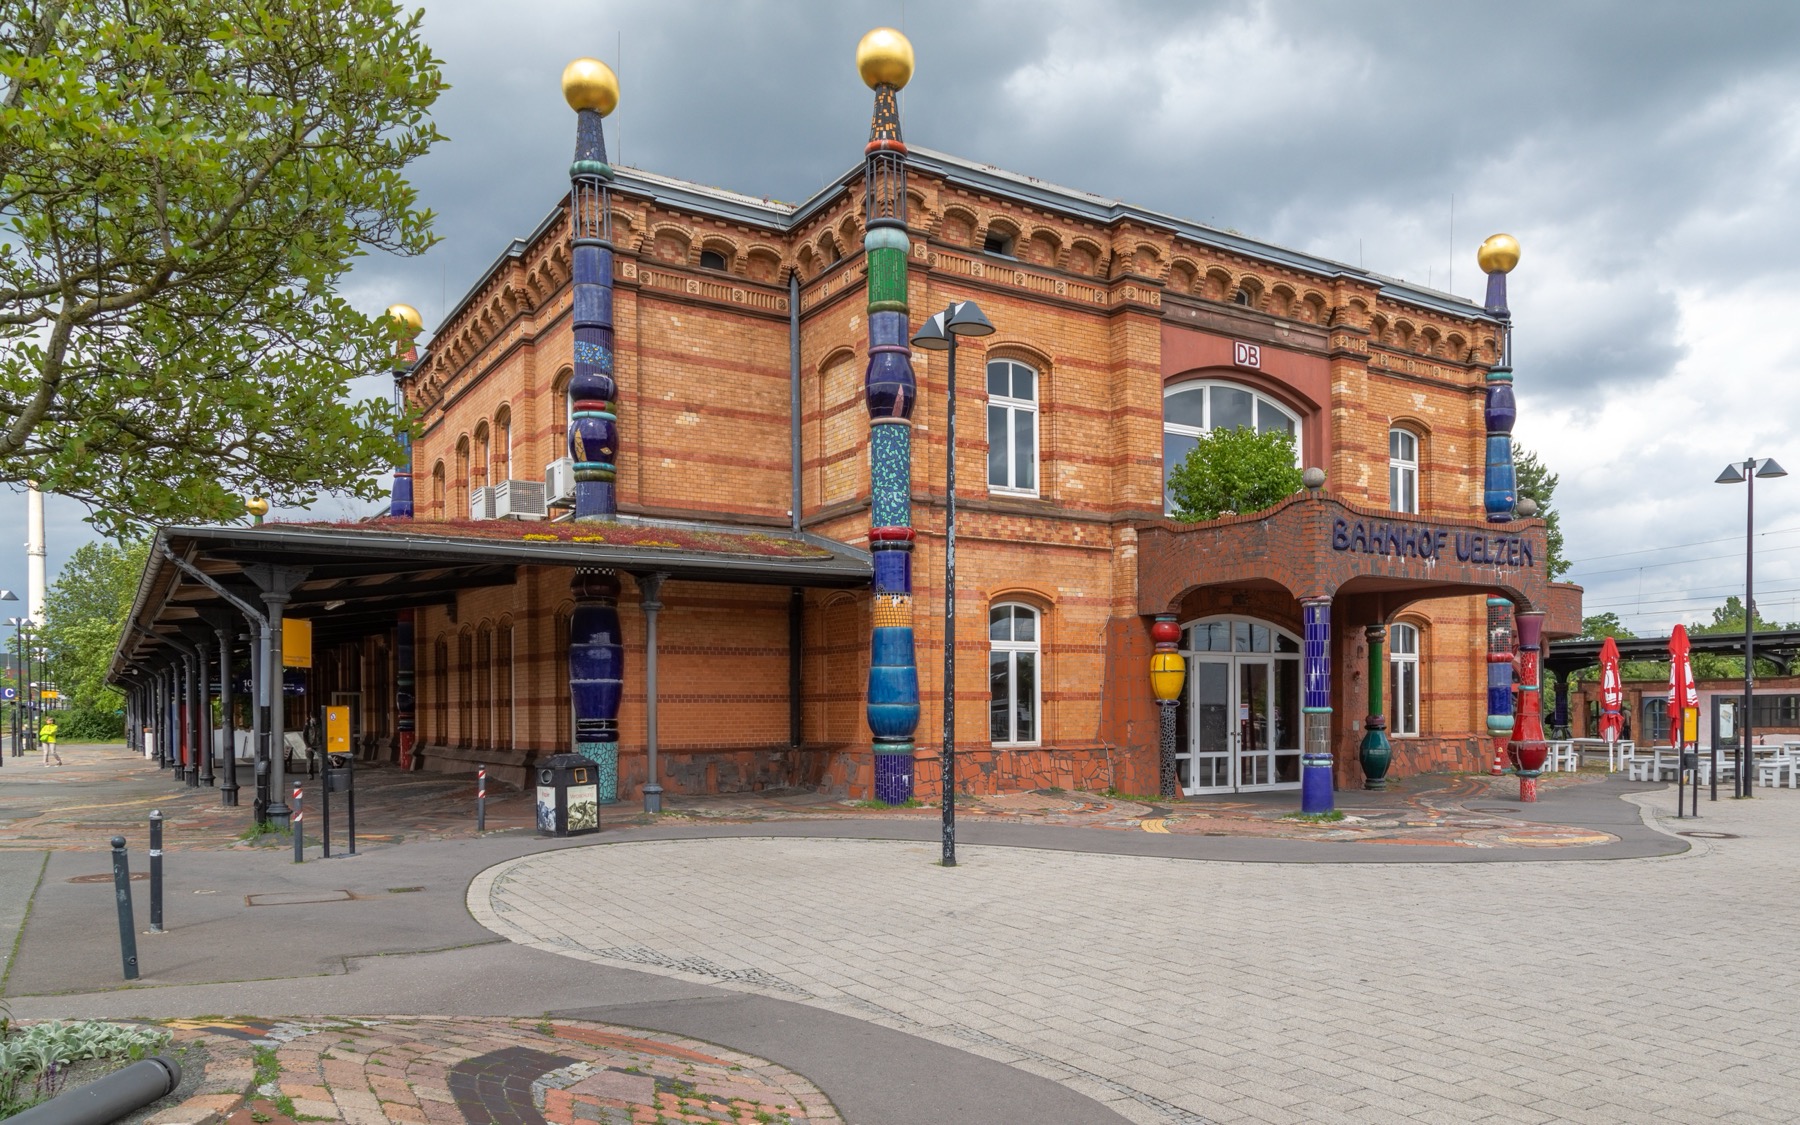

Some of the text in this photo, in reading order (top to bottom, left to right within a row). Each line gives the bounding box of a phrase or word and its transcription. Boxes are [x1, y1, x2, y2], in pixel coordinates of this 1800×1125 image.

[1237, 343, 1258, 366] DB
[1332, 515, 1534, 567] BAHNHOF UELZEN
[4, 688, 14, 698] C
